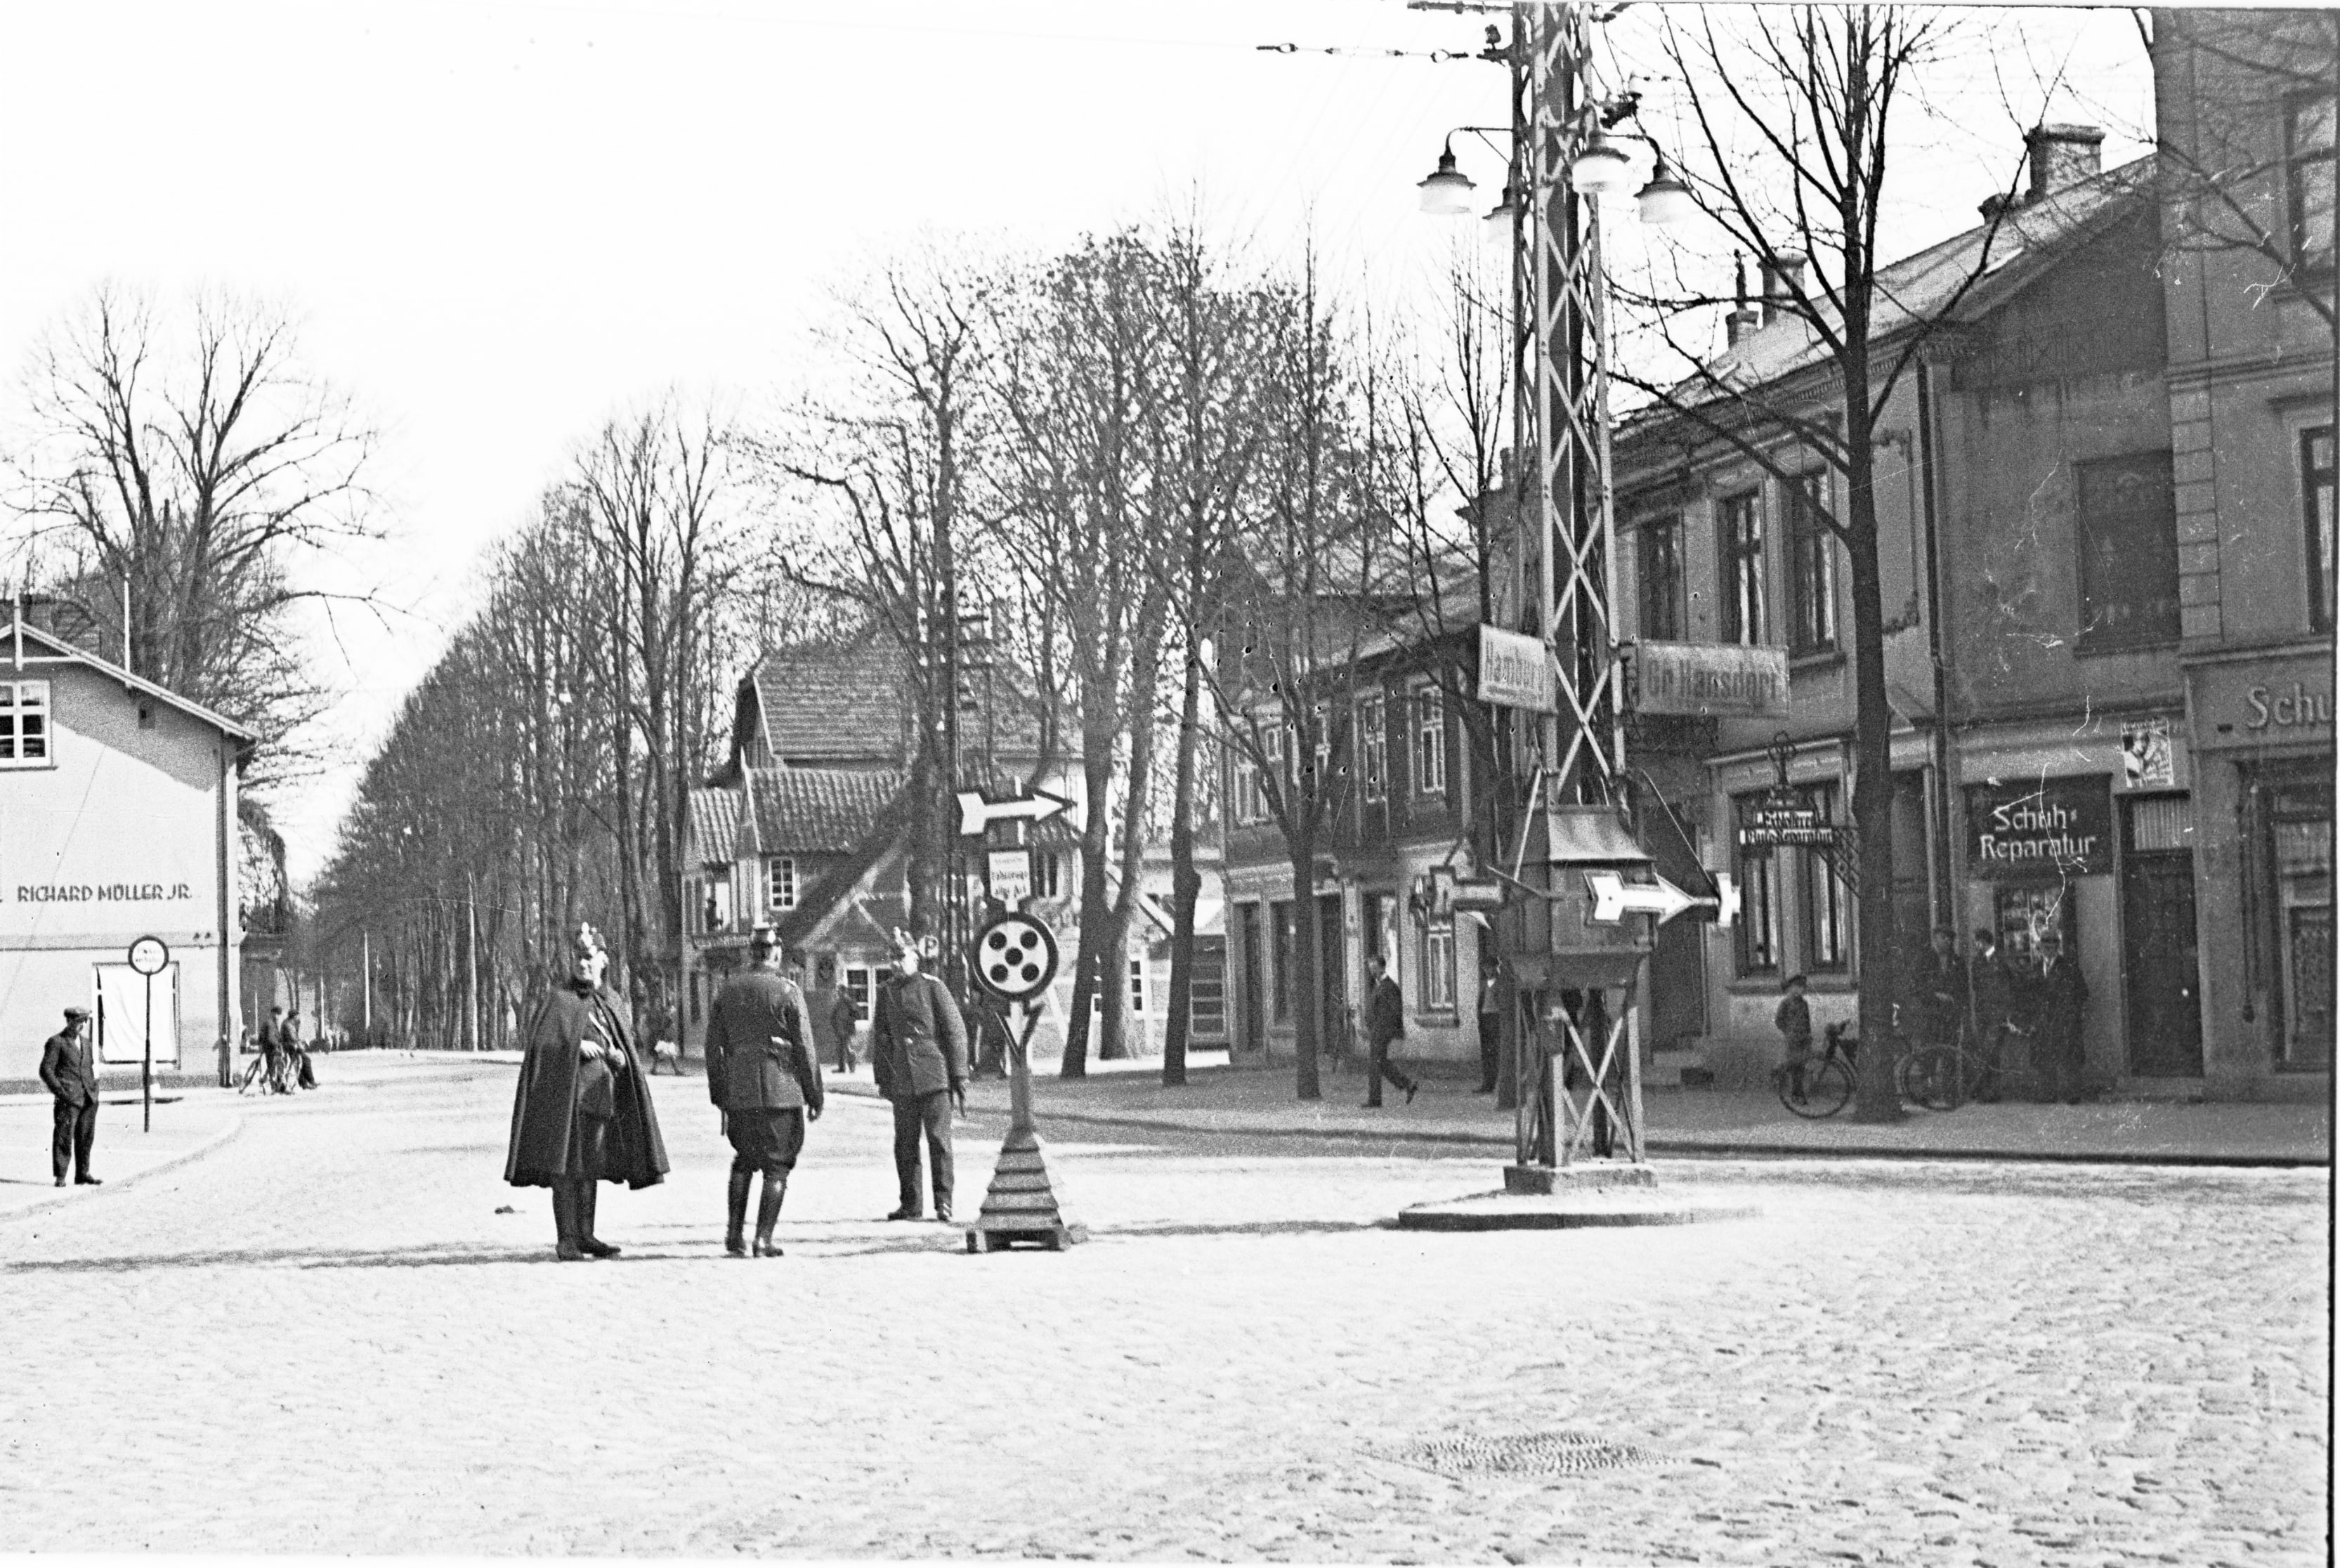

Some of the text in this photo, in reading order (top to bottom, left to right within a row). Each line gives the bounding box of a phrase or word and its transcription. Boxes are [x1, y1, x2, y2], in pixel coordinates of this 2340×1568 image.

[1979, 832, 2096, 862] Reparatur
[18, 885, 93, 902] RICHARD
[98, 884, 163, 901] MÜLLER
[924, 937, 937, 956] P
